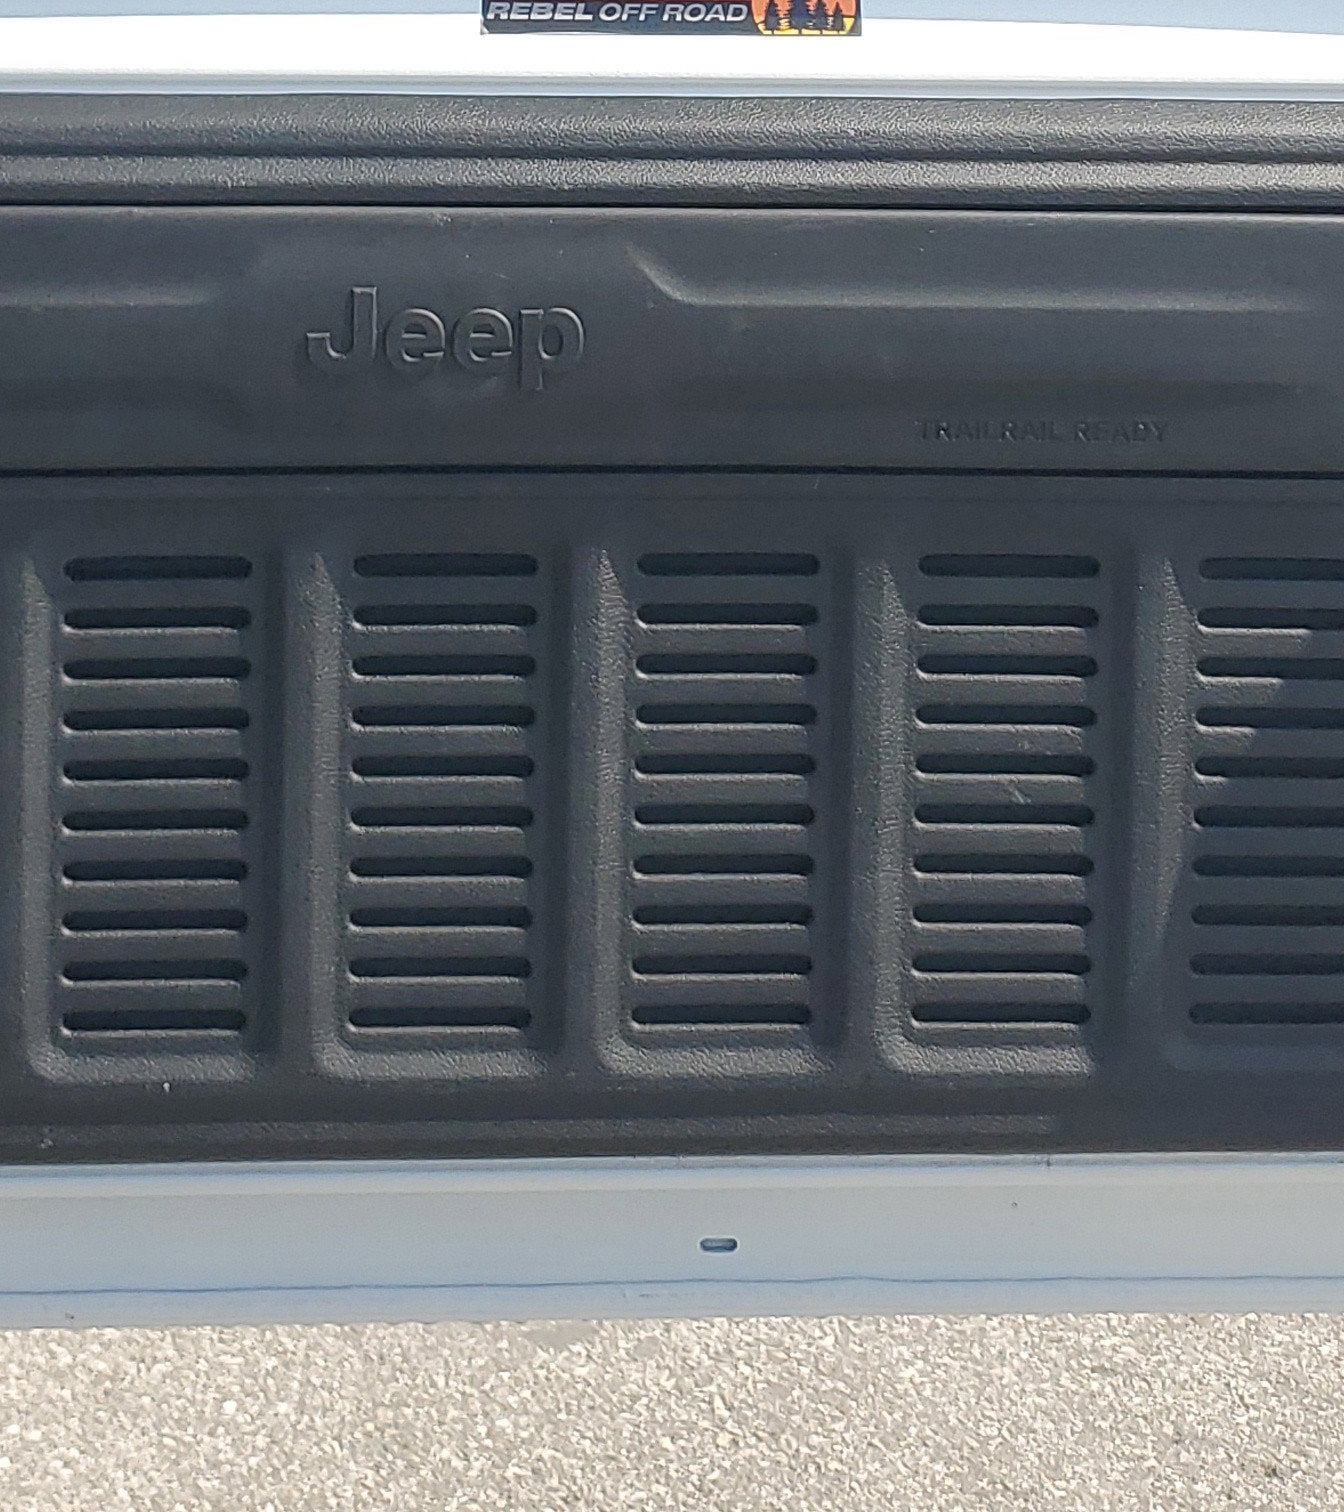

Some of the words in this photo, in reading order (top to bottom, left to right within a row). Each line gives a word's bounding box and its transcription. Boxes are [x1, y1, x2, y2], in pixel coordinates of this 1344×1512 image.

[486, 1, 594, 21] REBEL
[598, 2, 659, 22] OFF
[661, 3, 749, 23] ROAD
[304, 285, 586, 392] Jeep
